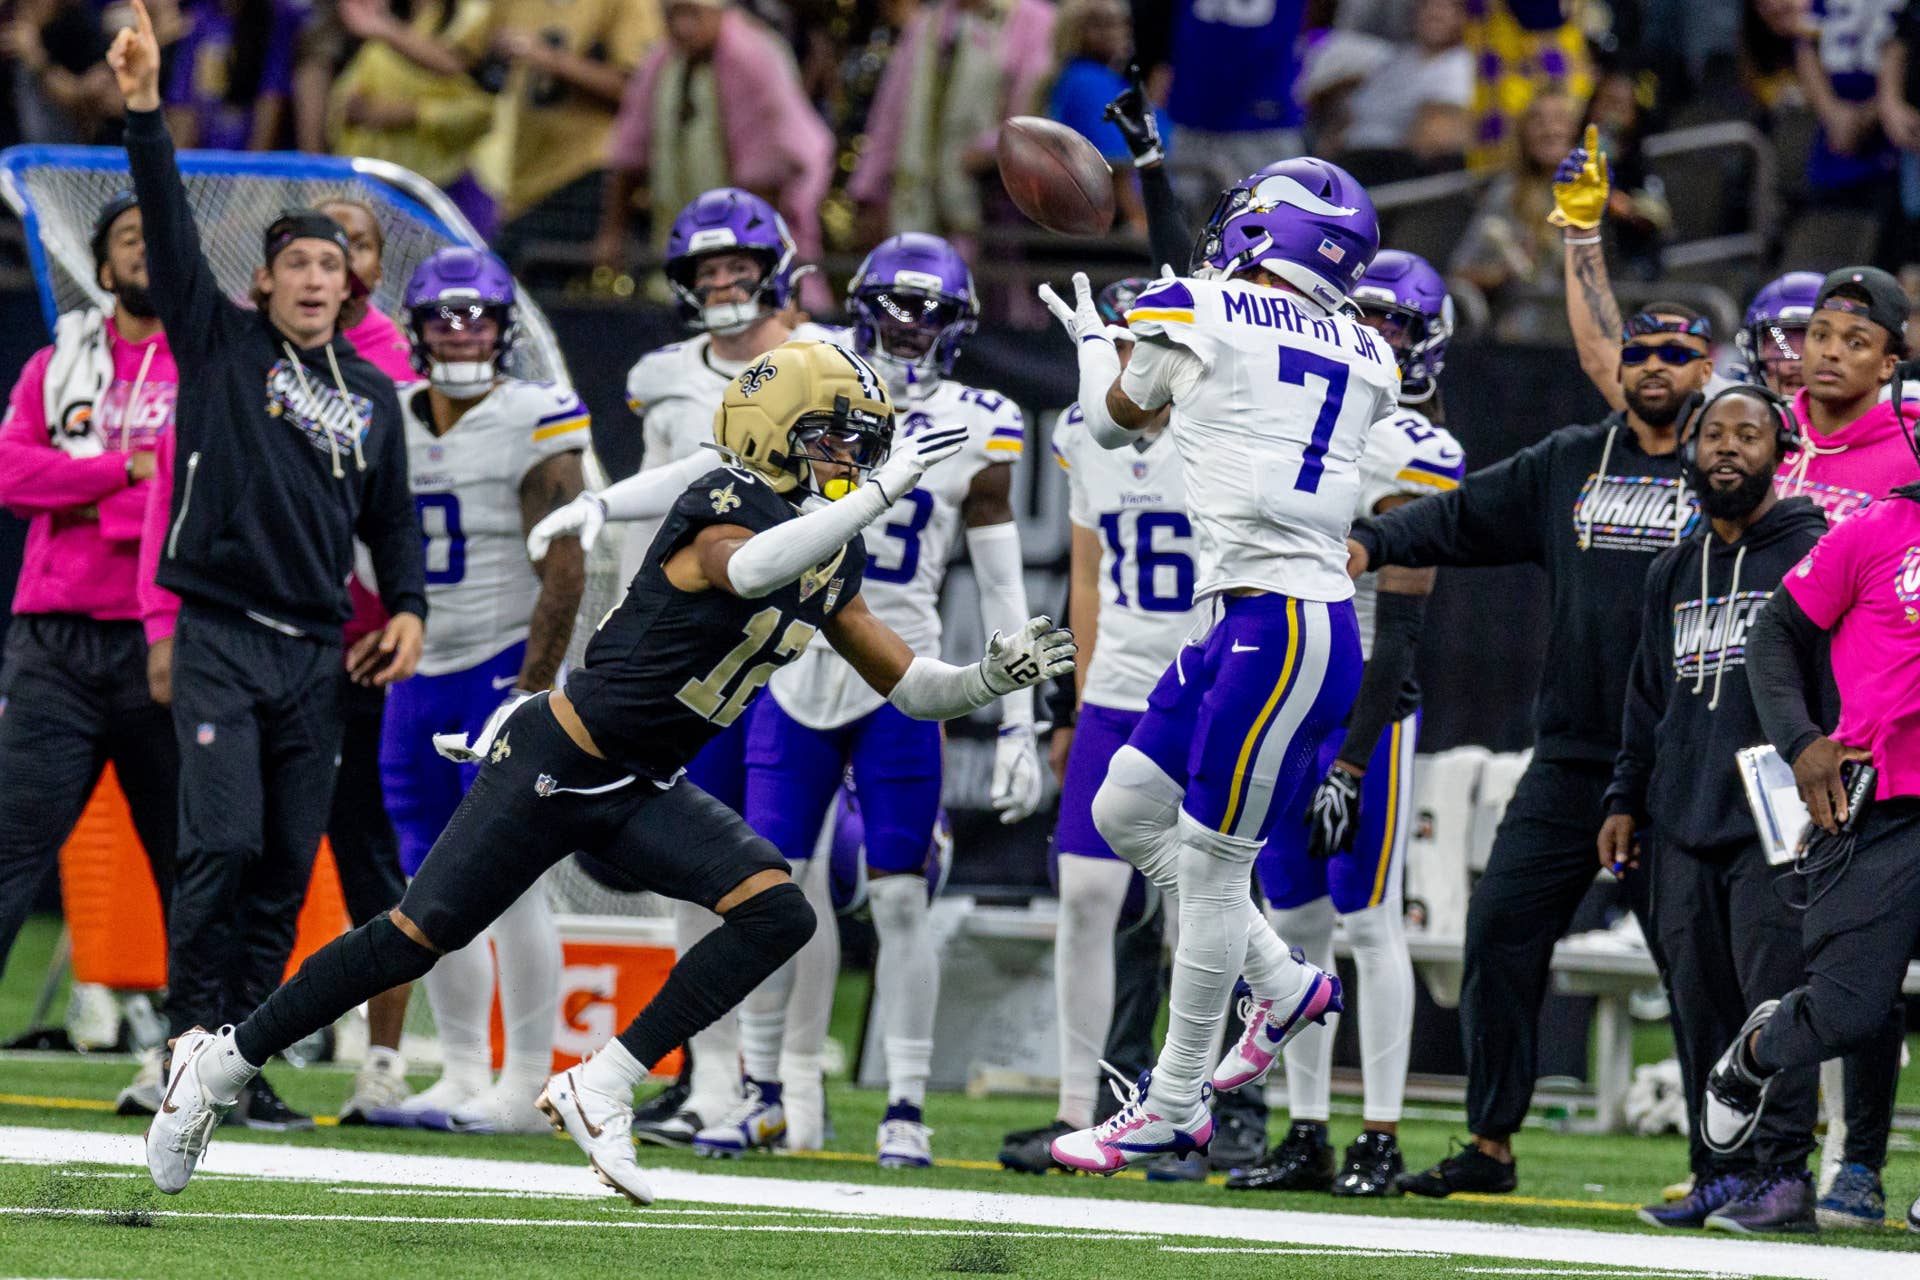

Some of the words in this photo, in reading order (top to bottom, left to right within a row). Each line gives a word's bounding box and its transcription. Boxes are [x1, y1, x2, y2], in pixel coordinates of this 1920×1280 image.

[1221, 290, 1342, 347] MURPHY
[1351, 323, 1382, 365] JR
[1278, 344, 1350, 494] 7
[1099, 512, 1194, 612] 16
[674, 606, 816, 727] 12
[1004, 653, 1039, 684] 12
[556, 964, 618, 1056] G
